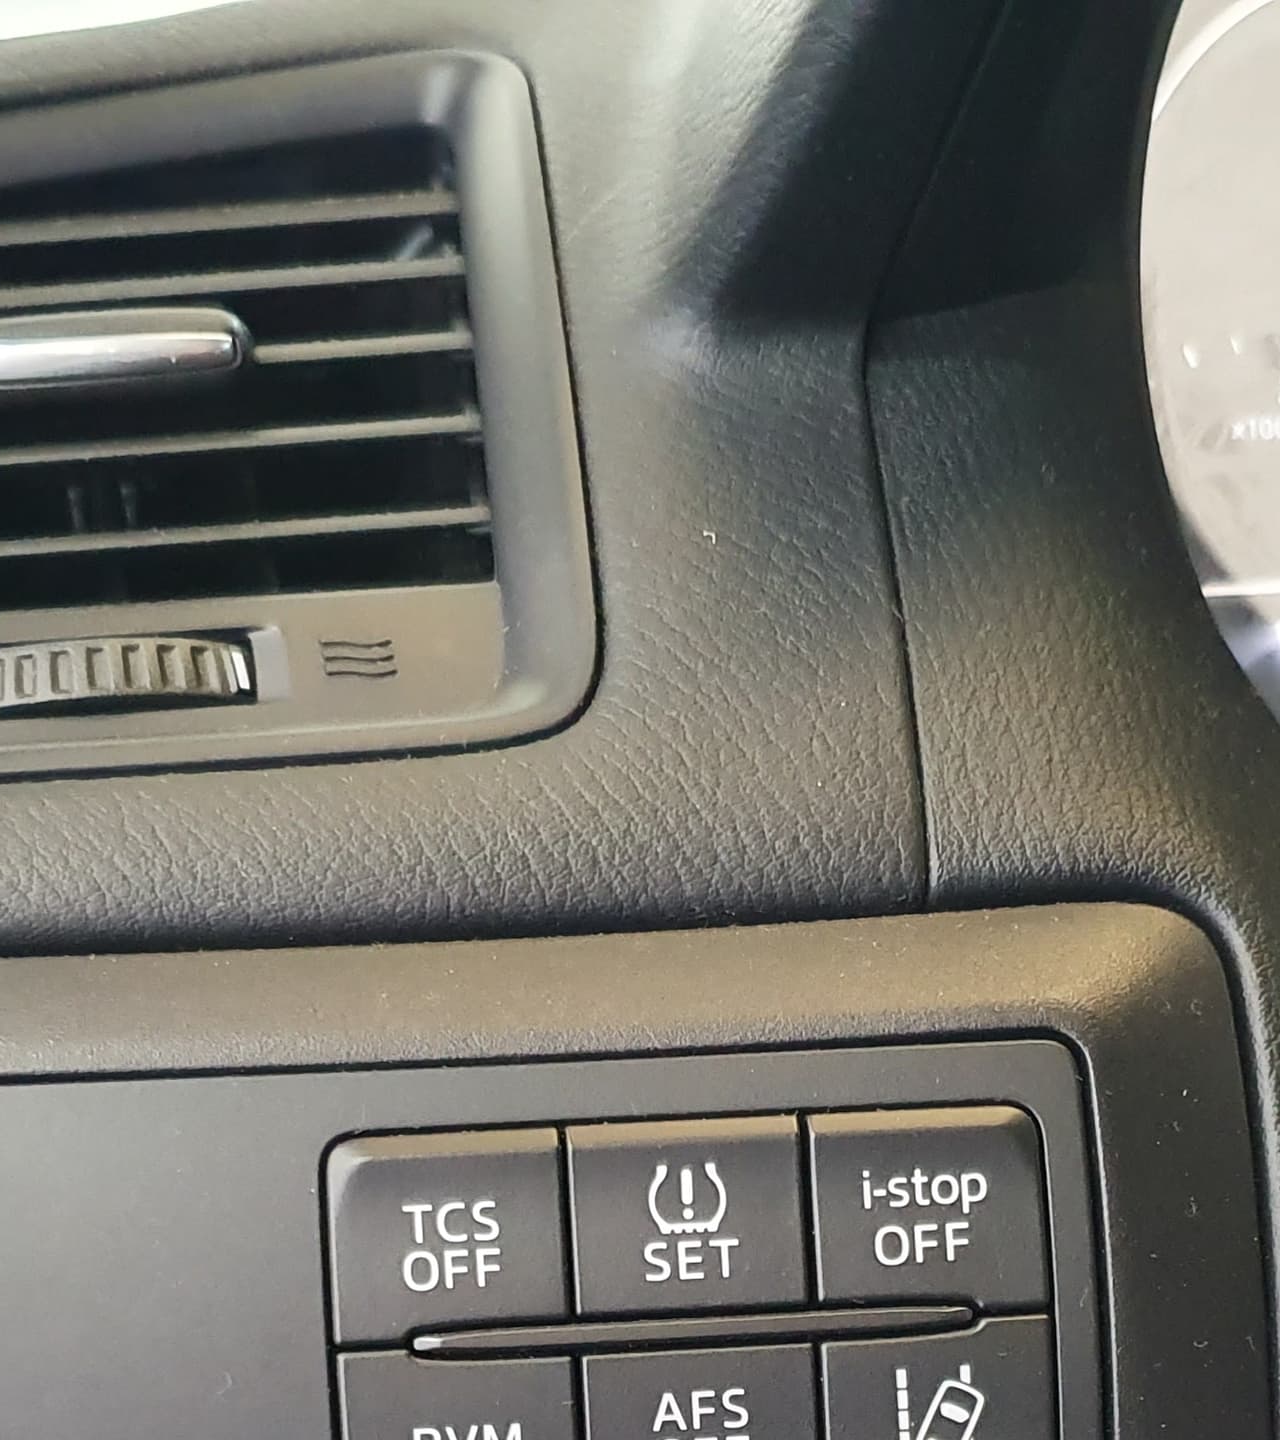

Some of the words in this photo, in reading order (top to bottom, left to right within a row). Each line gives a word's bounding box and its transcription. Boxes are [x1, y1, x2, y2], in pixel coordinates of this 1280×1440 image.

[861, 1167, 988, 1214] i-stop
[401, 1200, 501, 1246] TCS
[873, 1220, 971, 1267] OFF
[401, 1247, 502, 1293] OFF
[644, 1238, 741, 1282] SET
[652, 1387, 750, 1432] AFS
